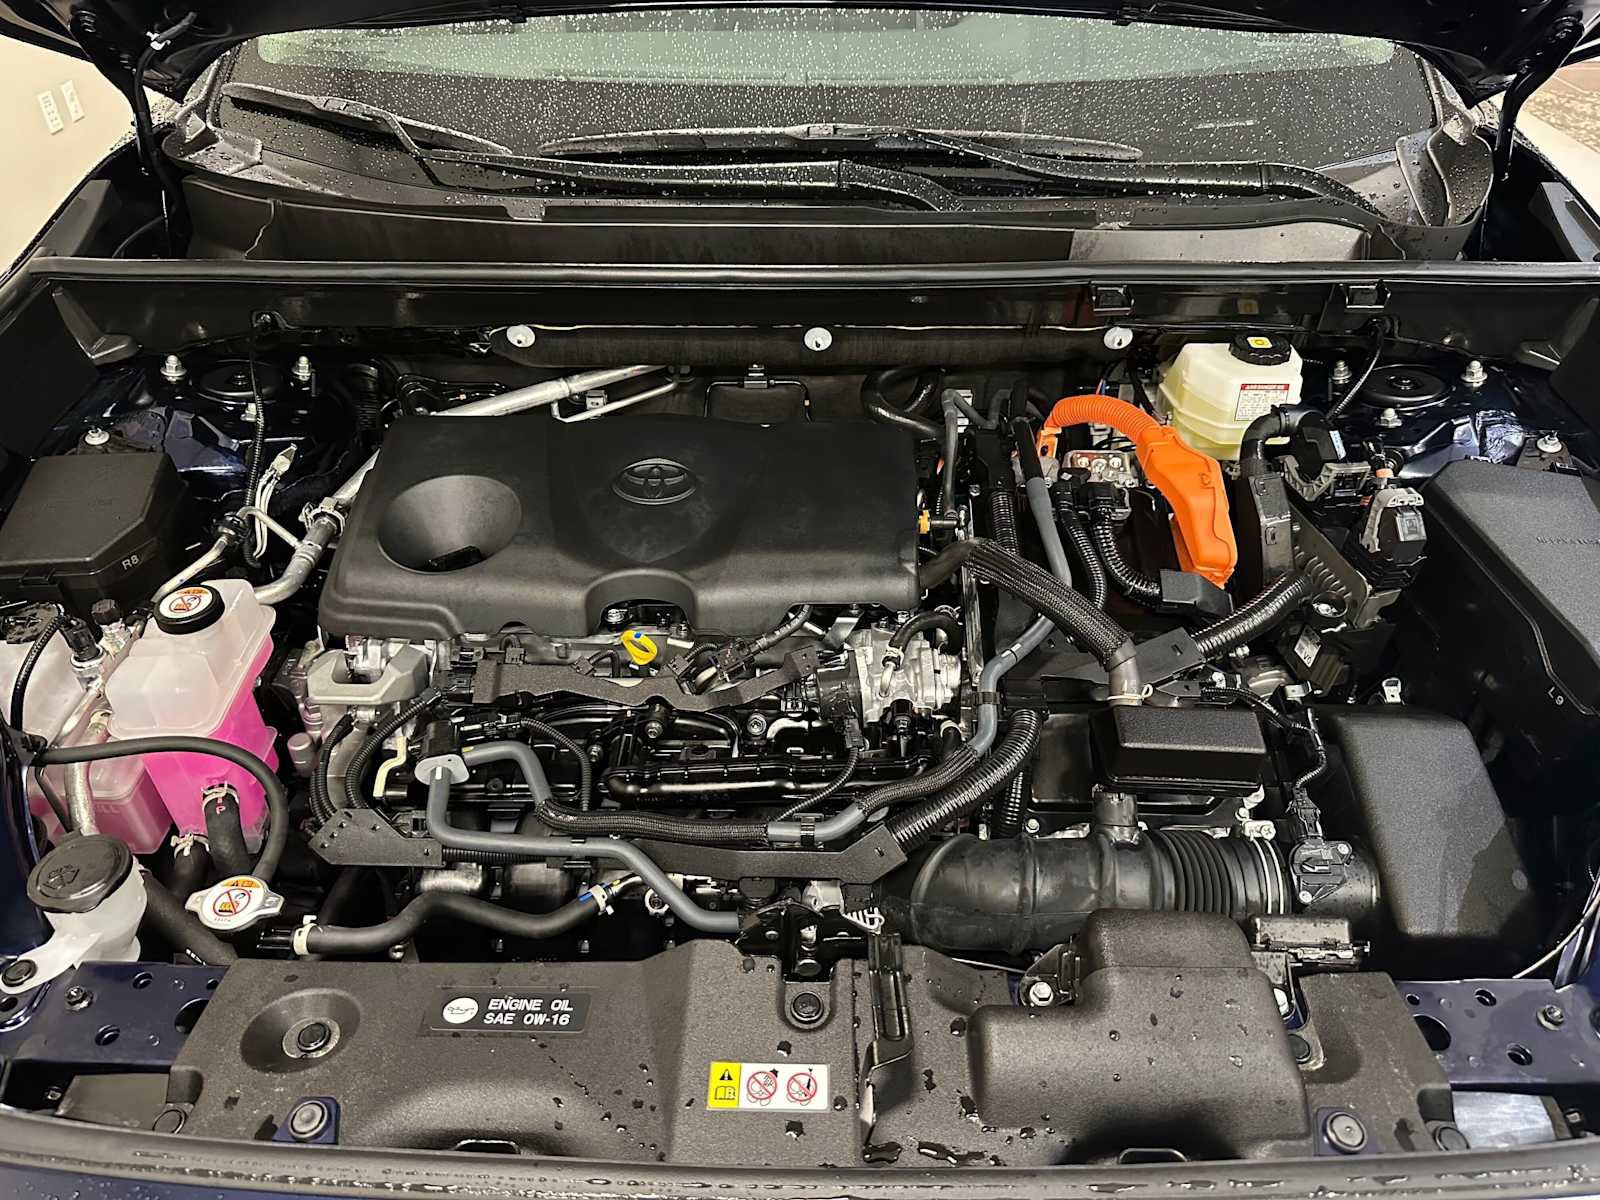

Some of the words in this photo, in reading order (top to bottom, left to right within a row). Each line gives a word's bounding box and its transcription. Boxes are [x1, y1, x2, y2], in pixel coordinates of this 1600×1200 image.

[122, 555, 140, 570] R8
[1548, 686, 1564, 705] L9
[488, 998, 543, 1011] ENGINE
[551, 999, 574, 1012] OIL
[484, 1012, 516, 1025] SAE
